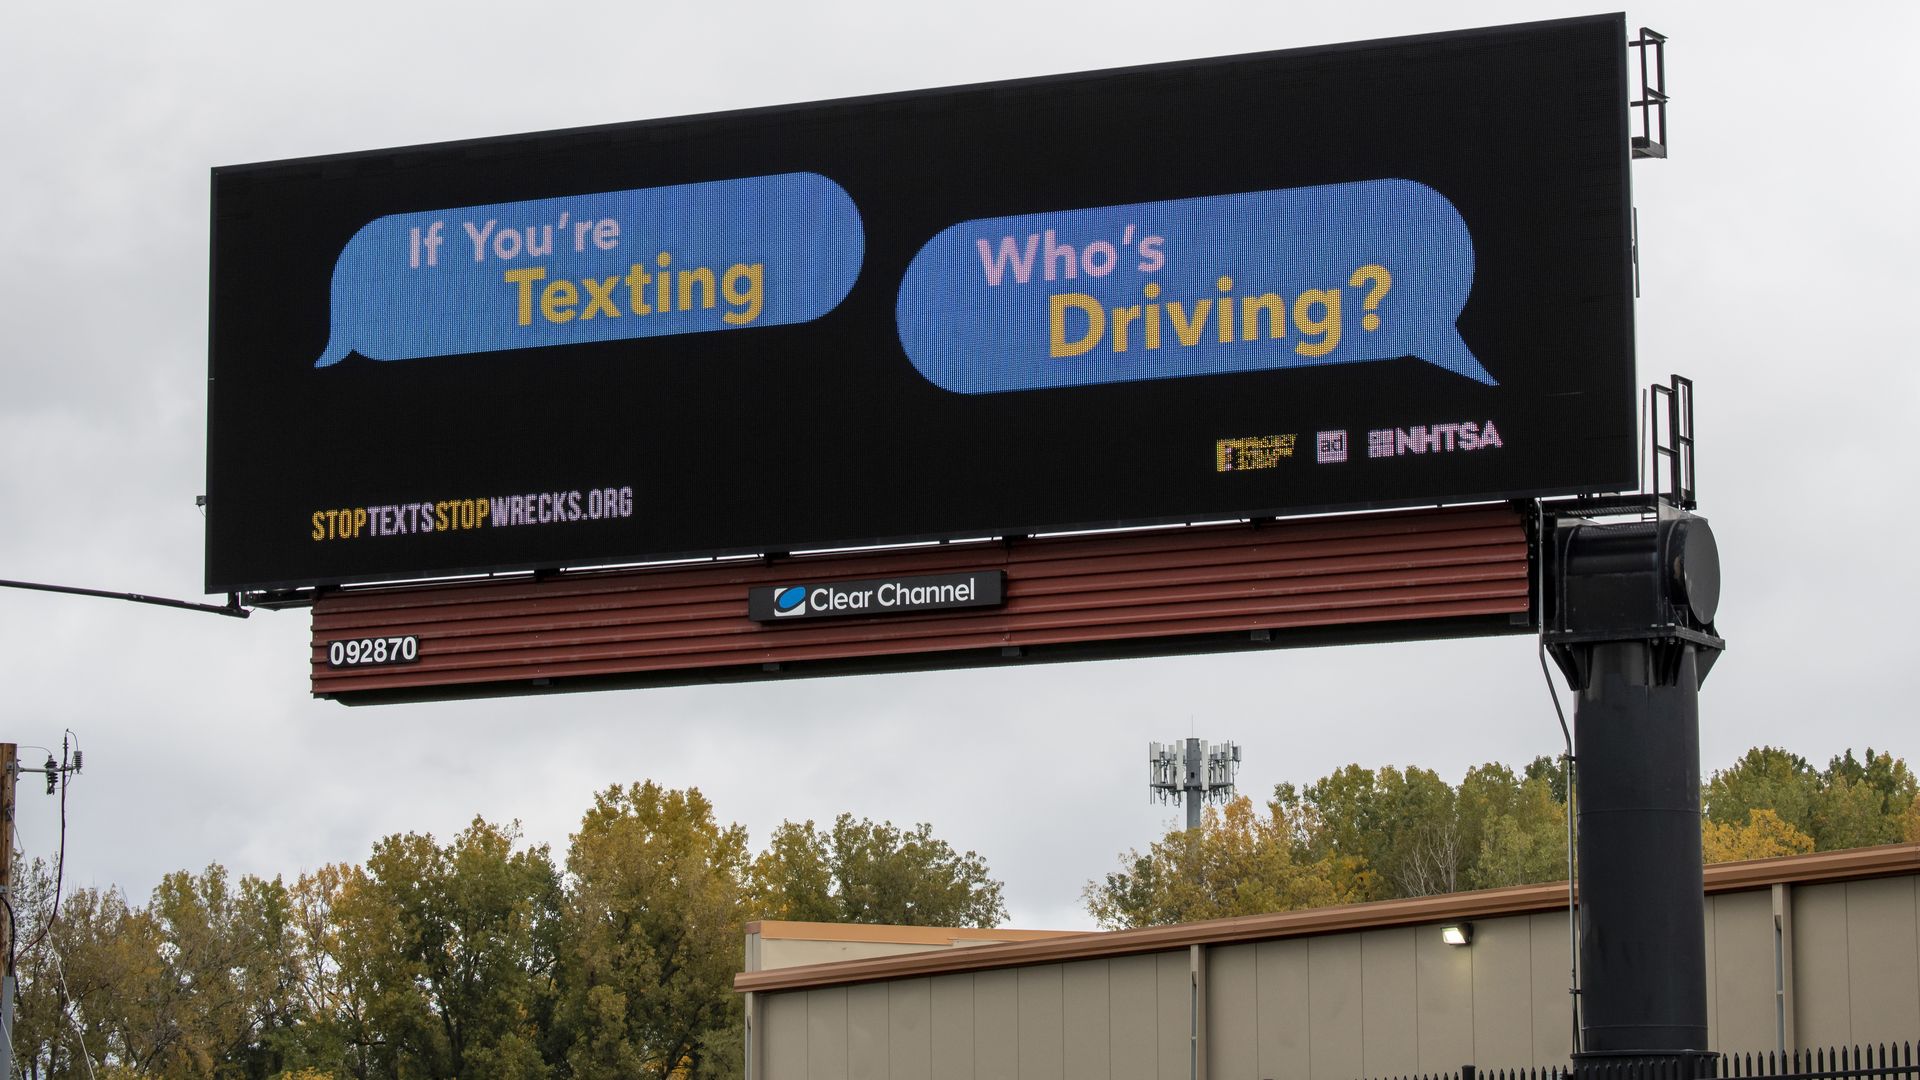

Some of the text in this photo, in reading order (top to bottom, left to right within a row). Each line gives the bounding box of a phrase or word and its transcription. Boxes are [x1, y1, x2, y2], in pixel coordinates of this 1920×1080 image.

[409, 212, 621, 270] If You're
[976, 224, 1165, 286] Who's
[504, 252, 764, 326] Texting
[1049, 264, 1392, 358] Driving?
[1396, 419, 1503, 456] NHTSA
[312, 486, 633, 542] STOPTEXTSSTOPWRECKS.ORG
[810, 577, 976, 612] Clear Channel
[330, 635, 417, 666] 092870
